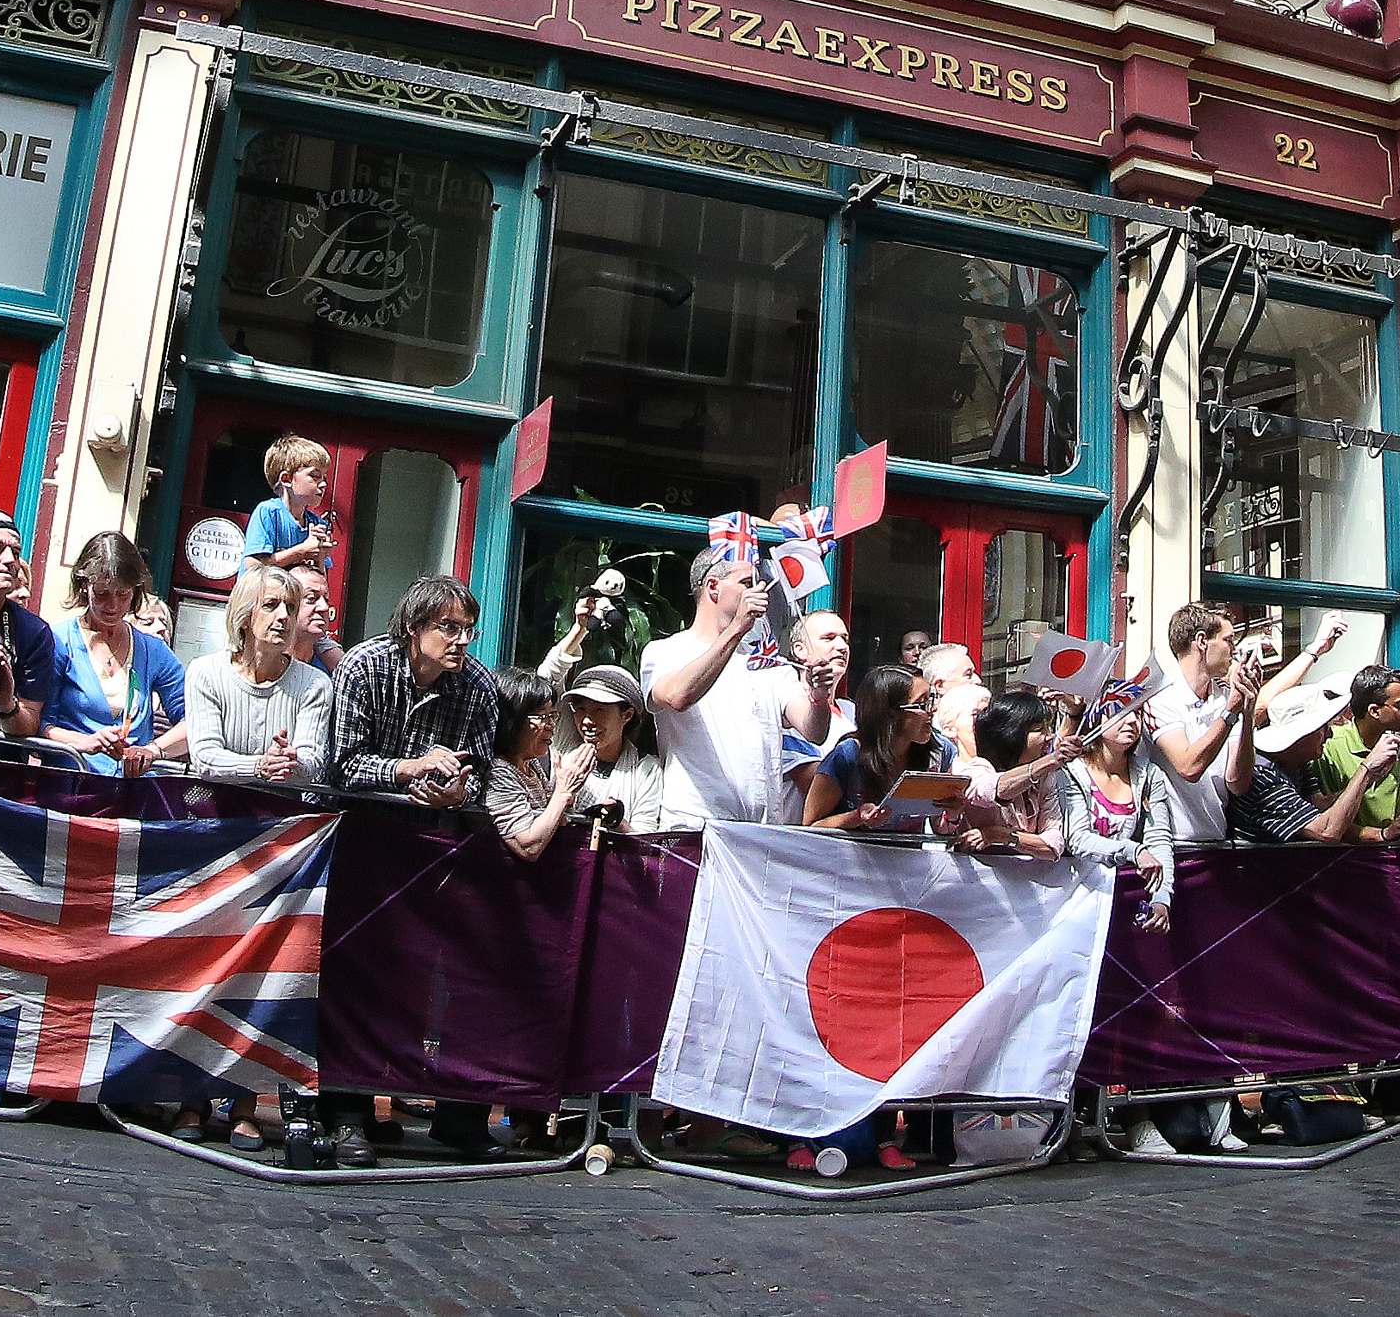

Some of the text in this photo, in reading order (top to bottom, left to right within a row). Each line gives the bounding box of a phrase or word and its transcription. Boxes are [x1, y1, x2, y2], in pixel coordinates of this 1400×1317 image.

[1273, 132, 1319, 172] 22
[287, 186, 433, 241] restaurant
[302, 283, 424, 328] brasserie
[191, 546, 241, 564] GUIDE
